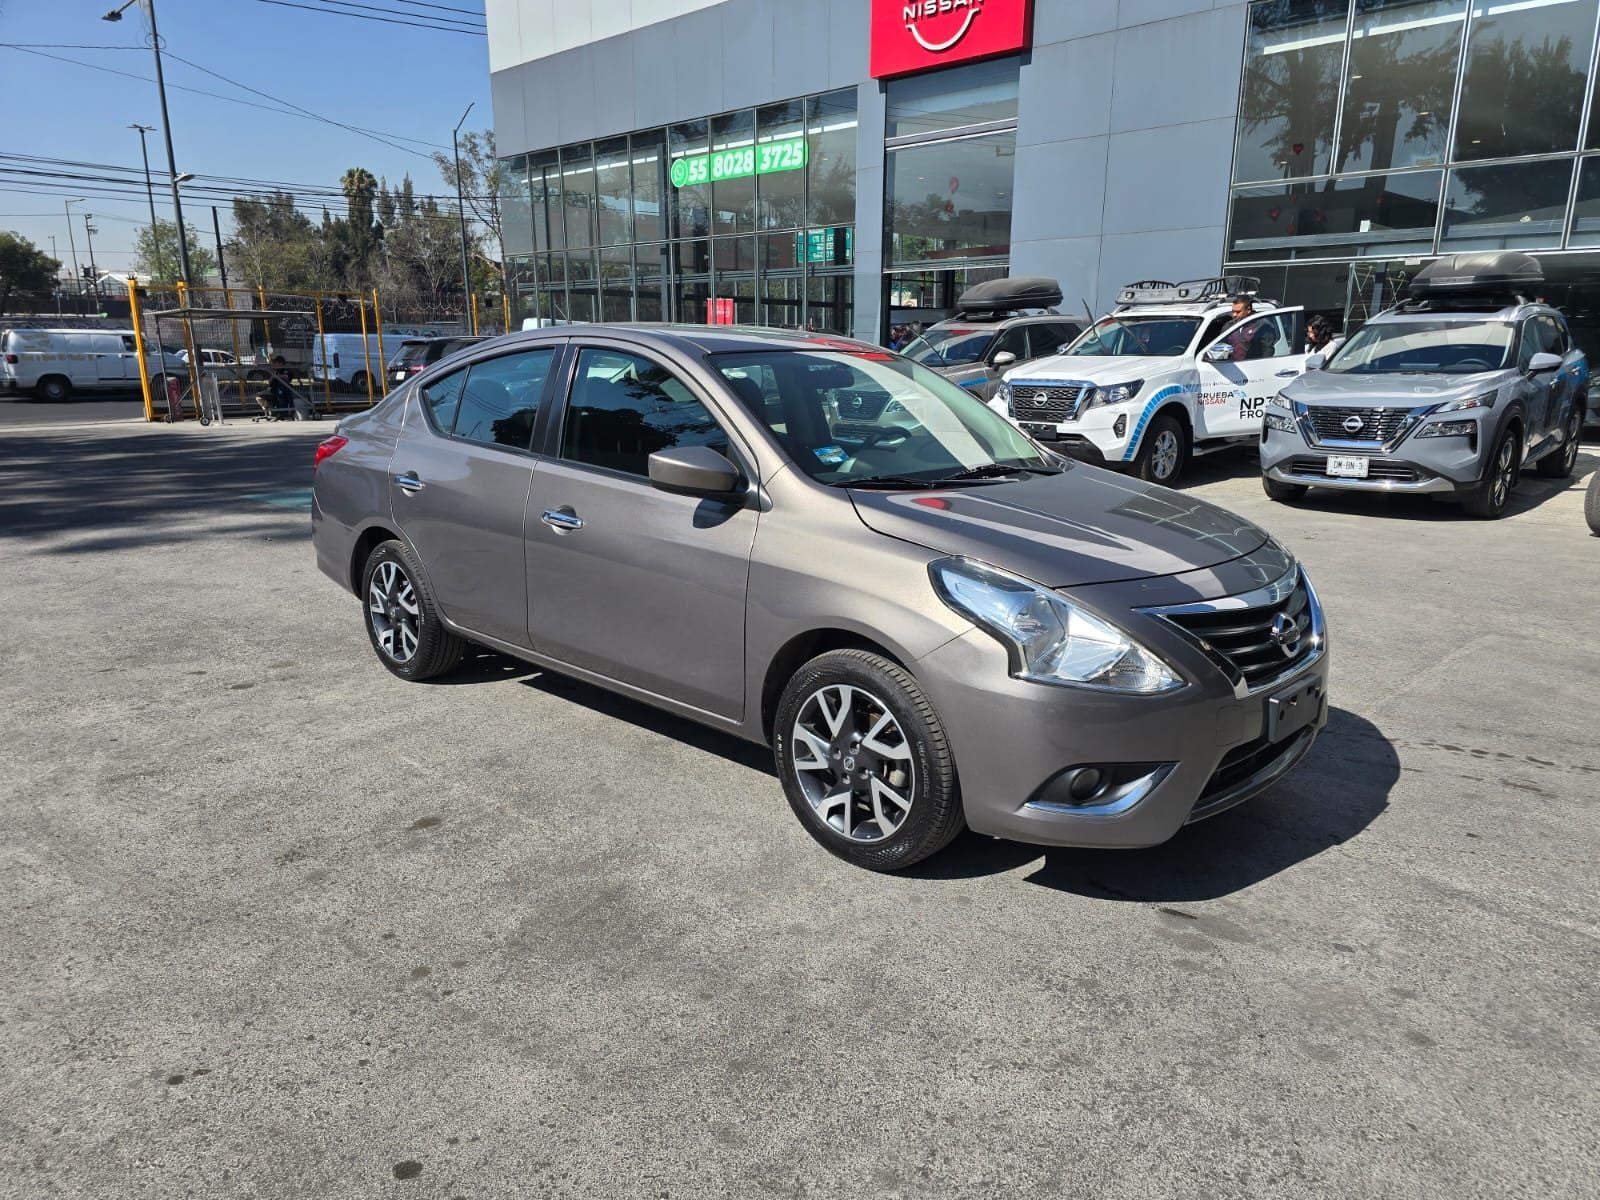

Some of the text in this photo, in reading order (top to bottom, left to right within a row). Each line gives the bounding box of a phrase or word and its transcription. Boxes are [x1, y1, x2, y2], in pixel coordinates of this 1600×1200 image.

[688, 140, 803, 181] 55 8028 3725
[1197, 391, 1234, 399] PRUEBA
[1197, 398, 1226, 406] NISSAN
